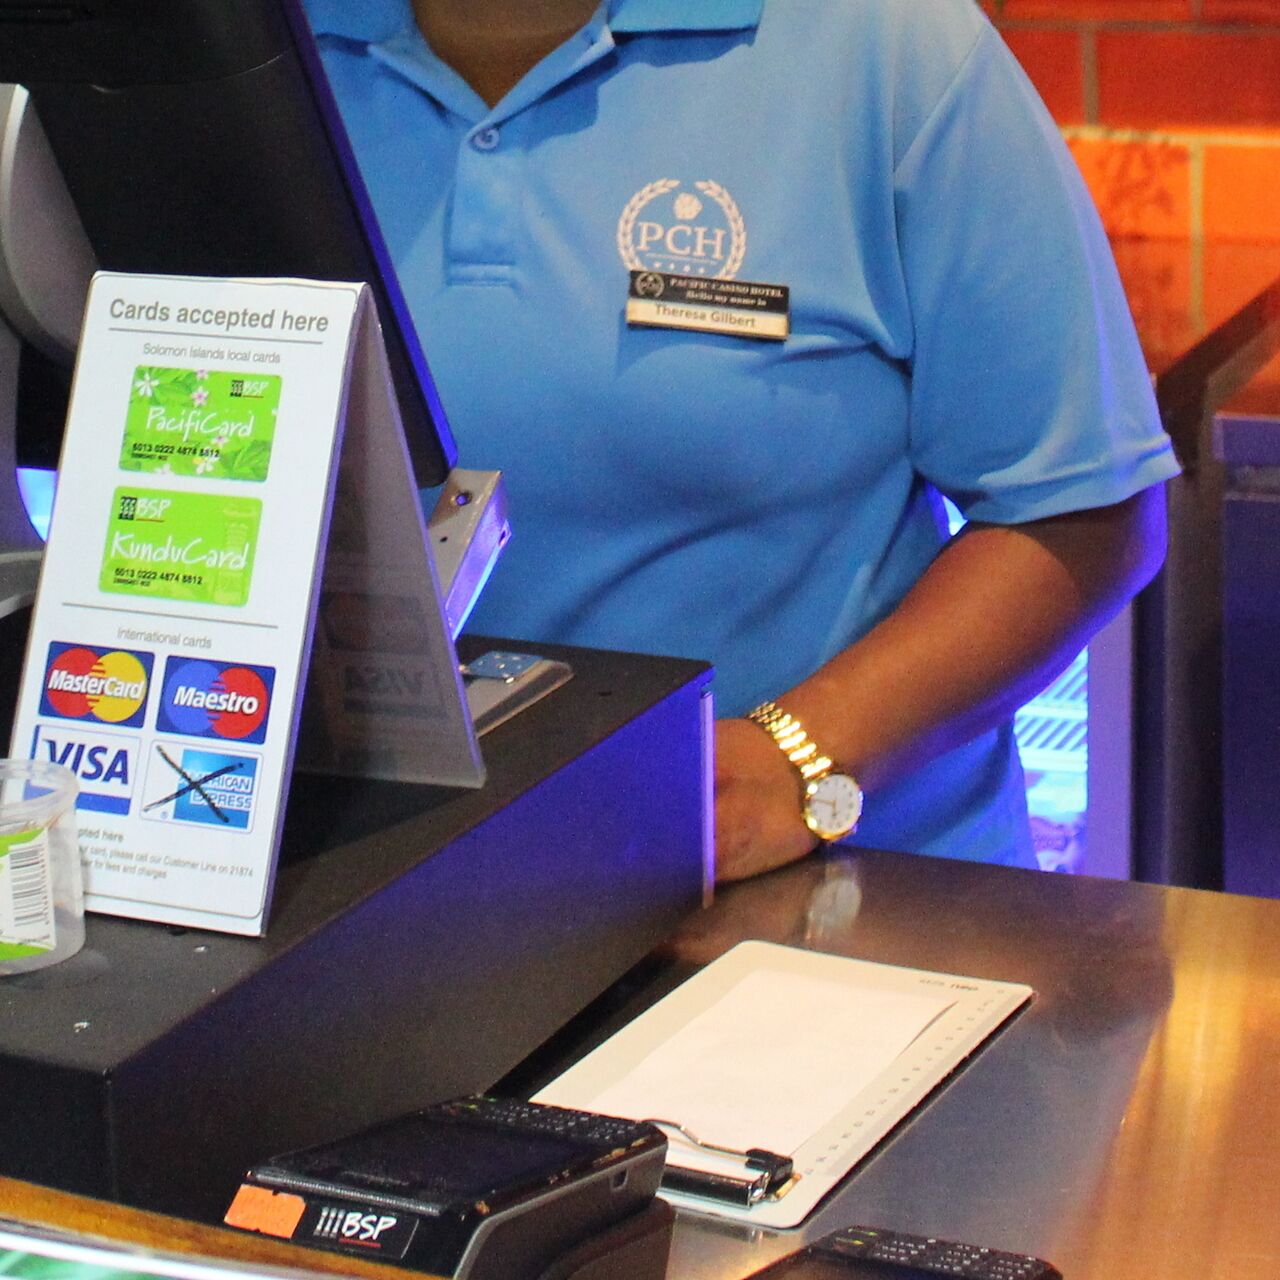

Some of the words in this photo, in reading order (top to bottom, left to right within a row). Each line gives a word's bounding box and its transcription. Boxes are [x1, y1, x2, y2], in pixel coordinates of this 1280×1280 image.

[637, 222, 726, 260] PCH
[686, 290, 713, 301] Hello
[714, 294, 728, 303] my
[729, 296, 756, 305] name
[757, 298, 767, 306] is
[750, 287, 784, 298] HOTEL
[109, 298, 170, 321] Cards
[176, 307, 276, 331] accepted
[280, 312, 329, 332] here
[654, 303, 707, 322] Theresa
[710, 311, 756, 328] Gilbert
[143, 342, 186, 357] Solomon
[190, 347, 224, 360] Islands
[227, 348, 250, 362] local
[253, 351, 280, 363] cards
[146, 406, 254, 442] PacifiCard
[136, 498, 171, 517] BSP
[110, 531, 250, 569] KunduCard
[117, 628, 180, 646] International
[183, 634, 212, 648] cards
[48, 670, 146, 700] MasterCard
[173, 686, 259, 714] Maestro
[42, 738, 129, 785] VISA
[340, 1212, 397, 1241] BSP
